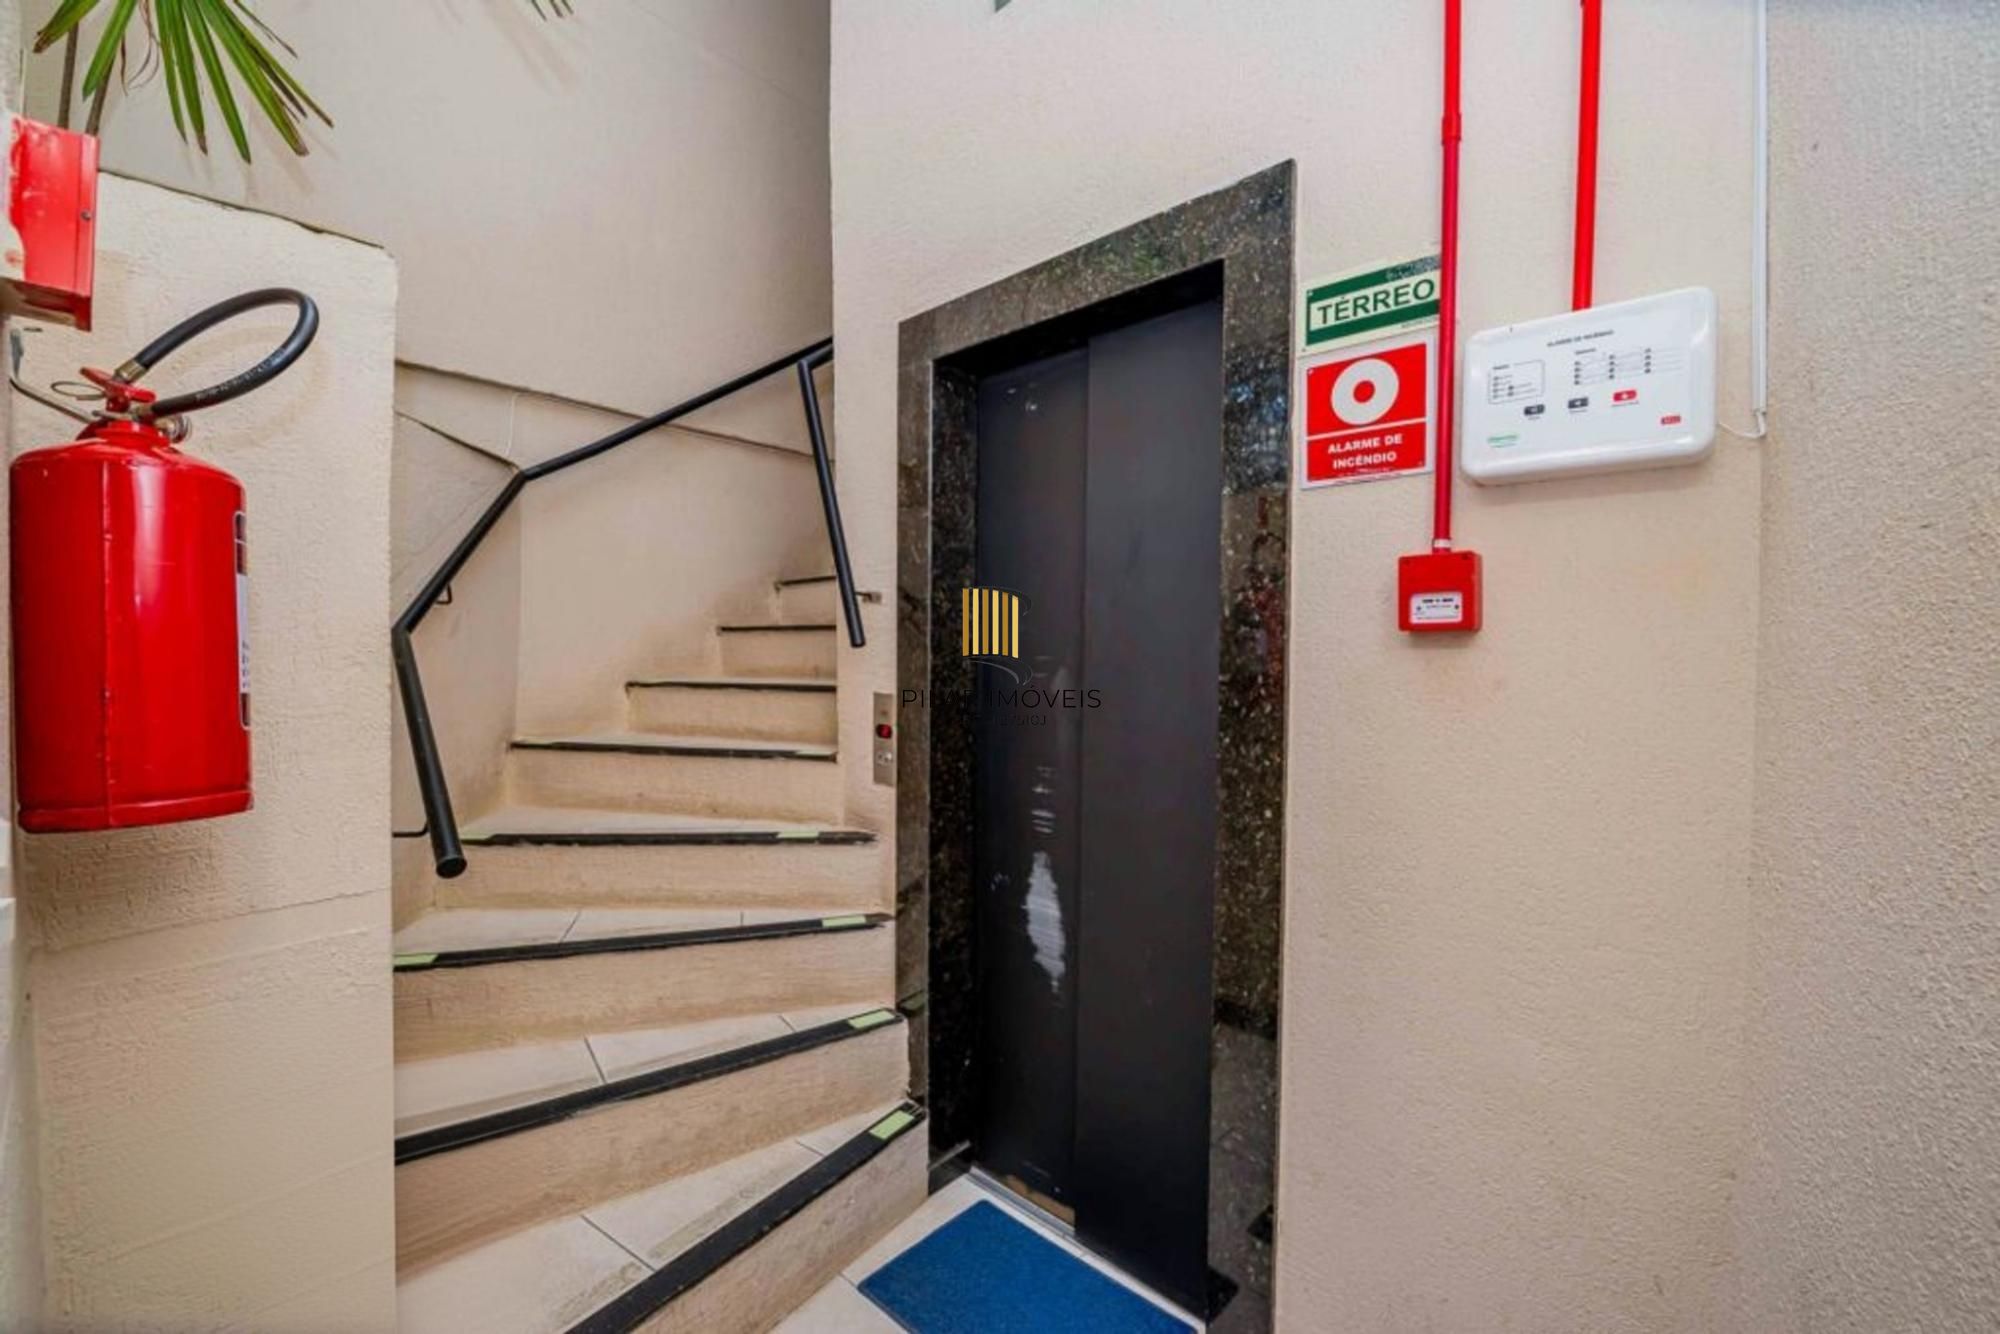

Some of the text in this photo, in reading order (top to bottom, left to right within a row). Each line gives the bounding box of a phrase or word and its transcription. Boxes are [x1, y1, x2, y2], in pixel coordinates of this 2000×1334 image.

[1317, 279, 1435, 324] TÉRREO
[1328, 434, 1403, 455] ALARME DE
